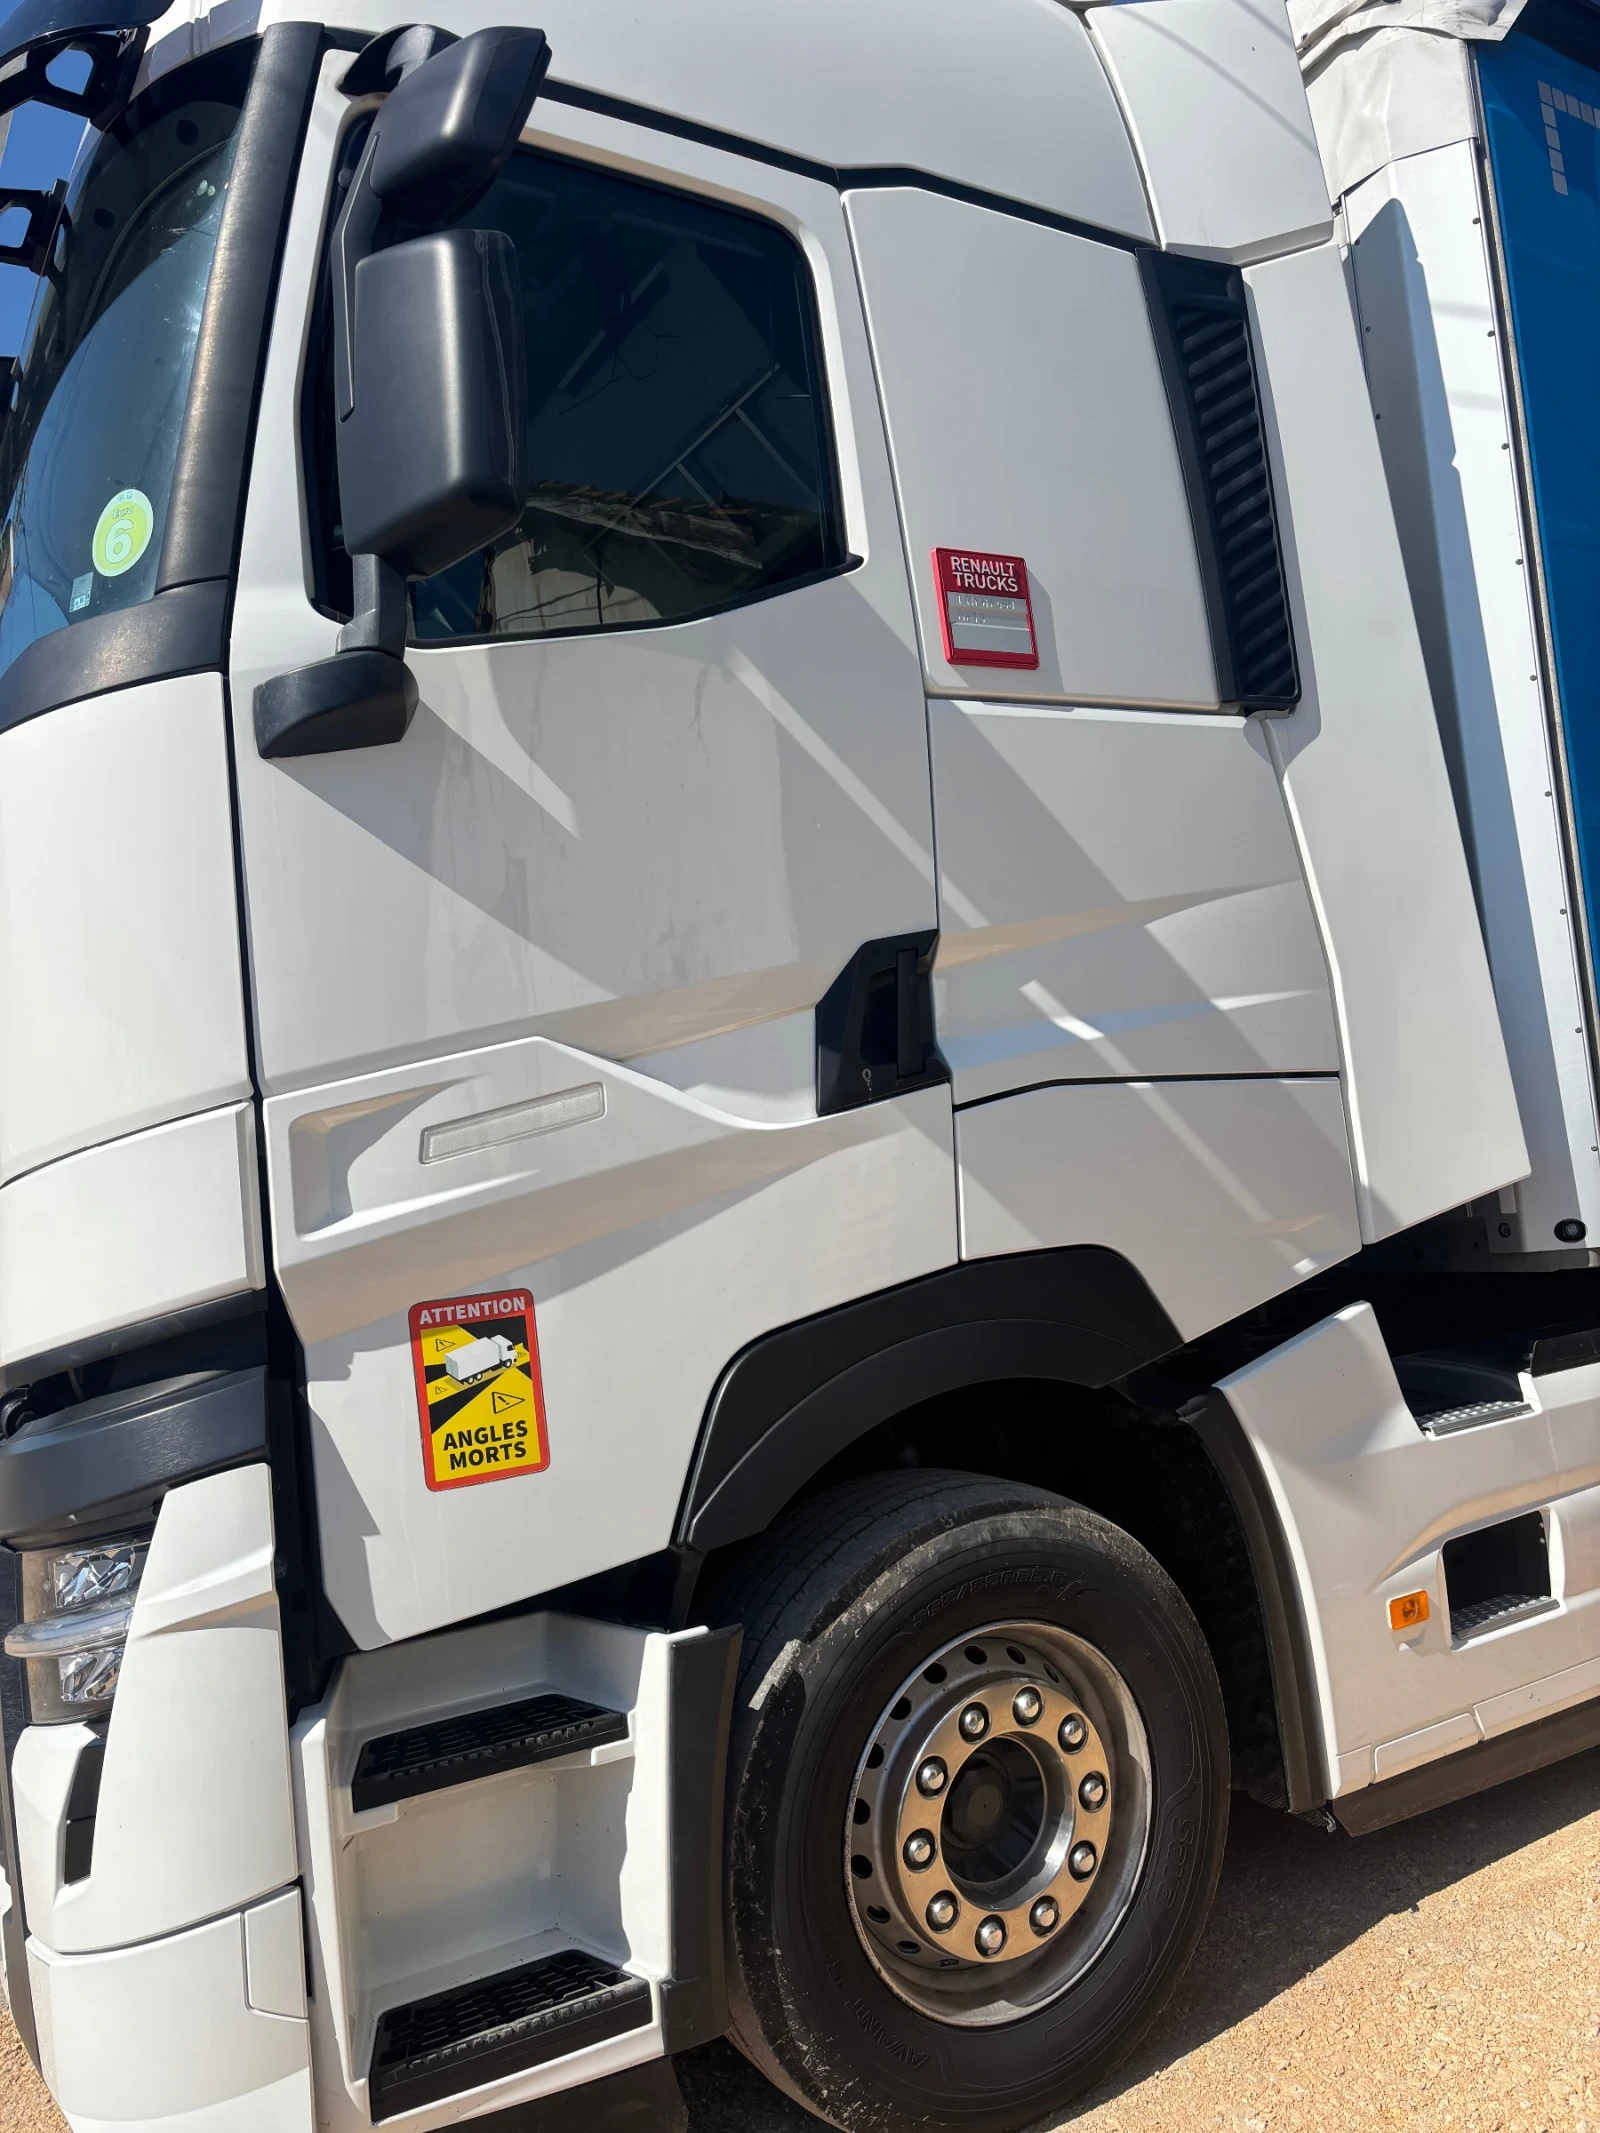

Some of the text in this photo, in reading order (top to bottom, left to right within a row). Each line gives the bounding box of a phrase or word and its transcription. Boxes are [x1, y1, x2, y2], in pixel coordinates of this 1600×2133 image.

[113, 507, 134, 519] Euro
[105, 518, 134, 565] 6
[950, 556, 1014, 577] RENAULT
[952, 572, 1018, 592] TRUCKS
[419, 1296, 526, 1325] ATTENTION
[443, 1420, 528, 1451] ANGLES
[449, 1441, 527, 1471] MORTS
